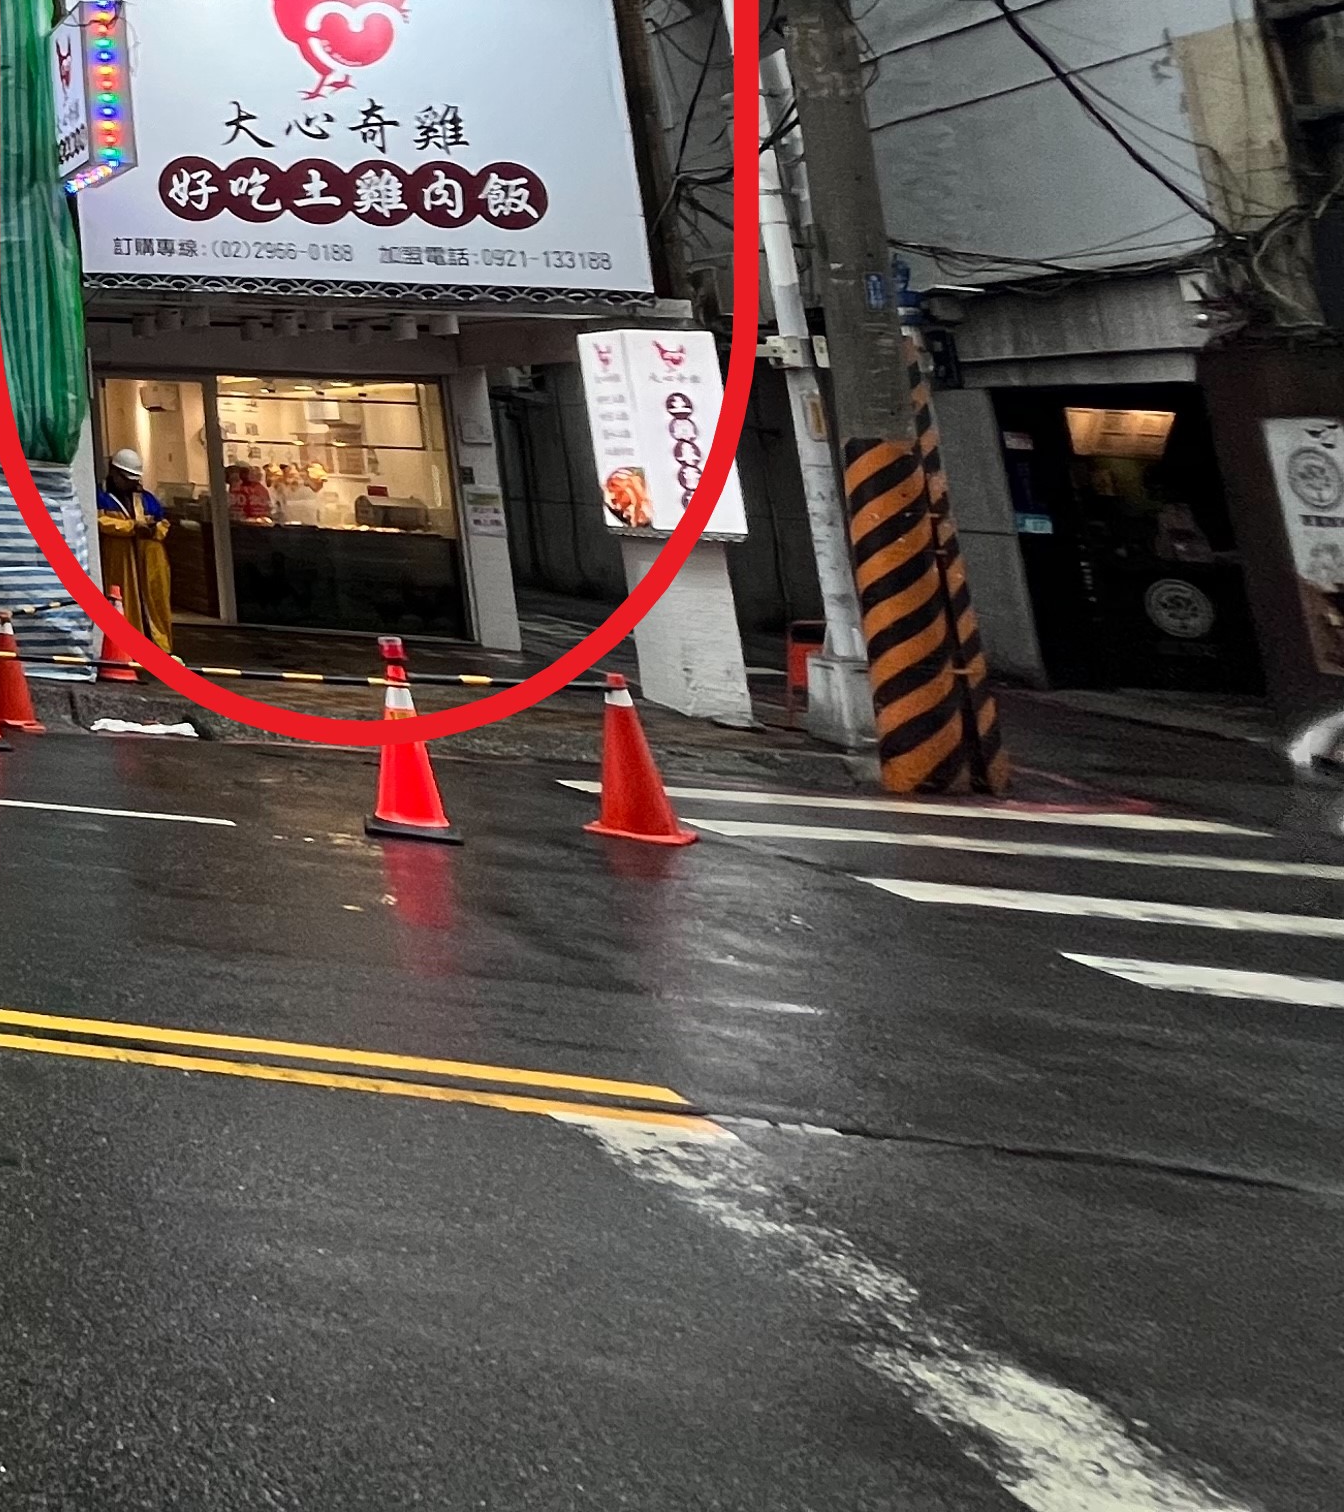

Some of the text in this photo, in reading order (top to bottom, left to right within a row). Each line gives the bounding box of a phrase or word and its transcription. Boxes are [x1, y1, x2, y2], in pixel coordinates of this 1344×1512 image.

[221, 98, 470, 155] 大心奇雞
[167, 168, 540, 219] 好吃土雞肉飯
